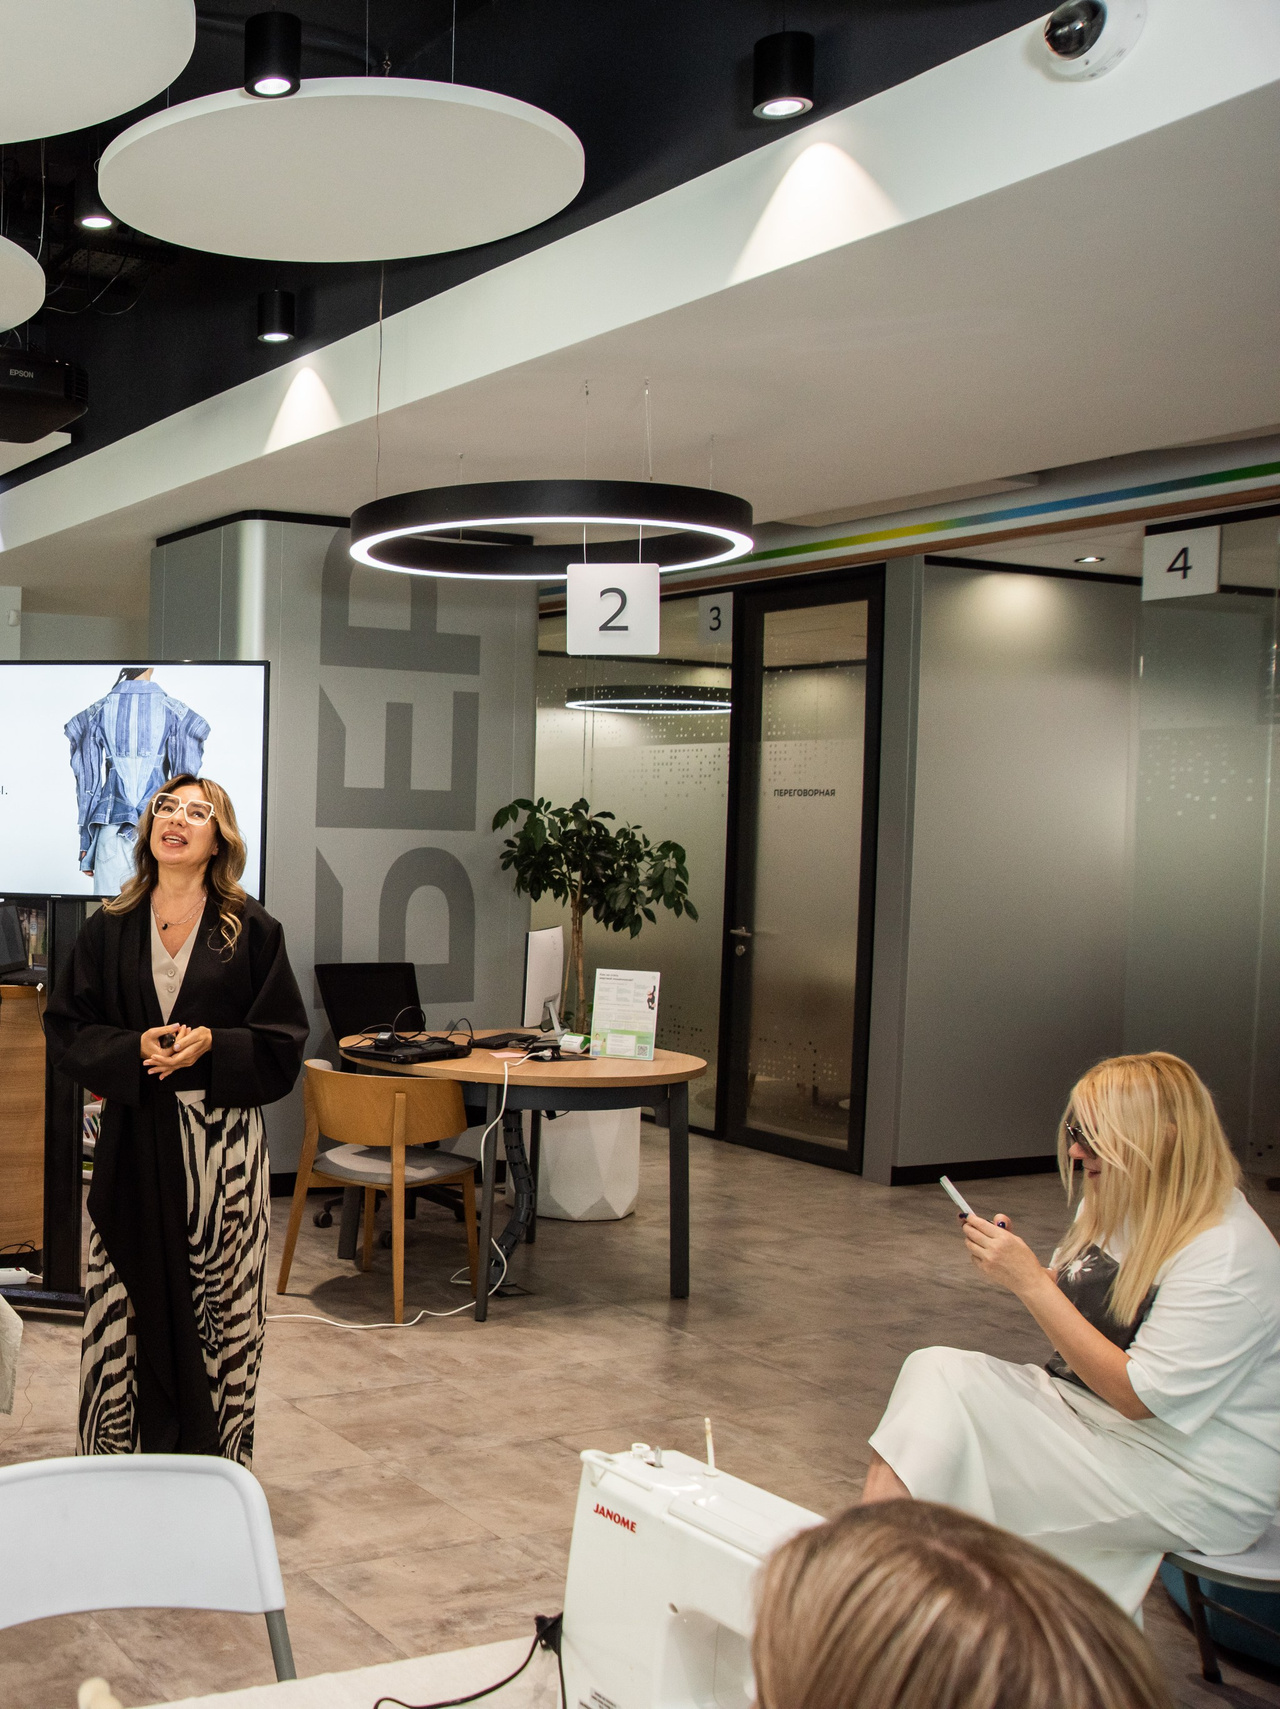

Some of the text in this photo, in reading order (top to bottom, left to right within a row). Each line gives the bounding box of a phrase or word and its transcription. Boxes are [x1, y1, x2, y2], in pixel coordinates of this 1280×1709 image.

[9, 368, 34, 379] EPSON
[1166, 546, 1193, 580] 4
[598, 587, 629, 632] 2
[709, 606, 722, 632] 3
[313, 526, 482, 1030] БЕР
[773, 788, 837, 797] ПЕРЕГОВОРНАЯ
[593, 1503, 637, 1534] JANOME
